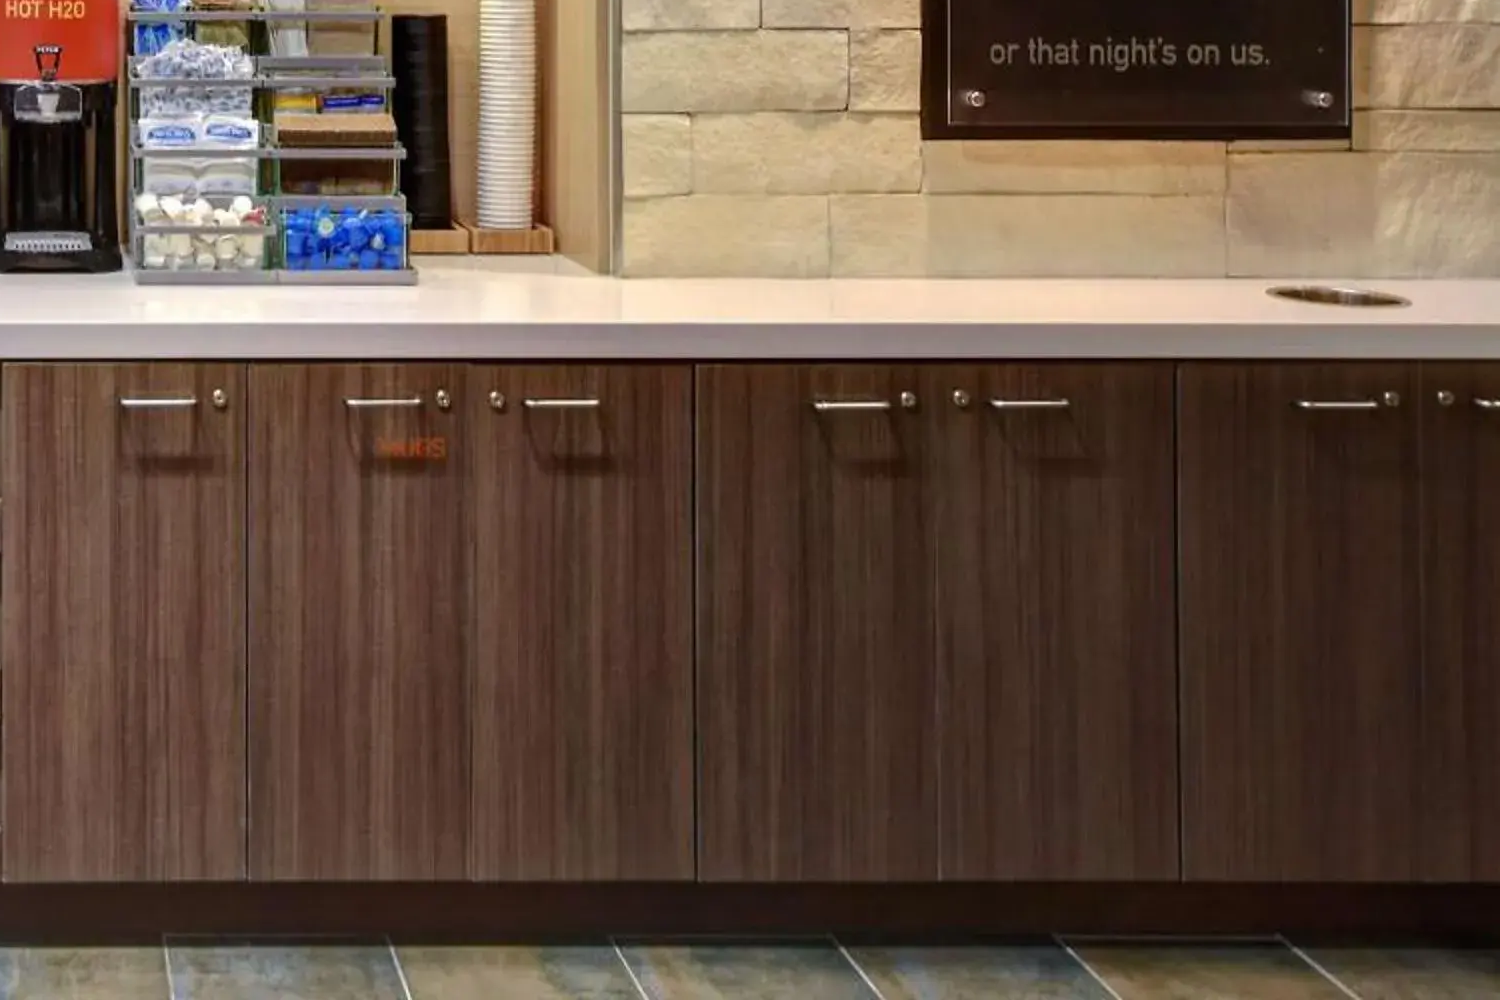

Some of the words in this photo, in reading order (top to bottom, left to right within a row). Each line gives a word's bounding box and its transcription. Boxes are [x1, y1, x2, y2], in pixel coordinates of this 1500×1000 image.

[5, 0, 43, 19] HOT
[990, 43, 1017, 65] or
[1028, 37, 1079, 66] that
[1089, 37, 1177, 73] night's
[1187, 44, 1220, 65] on
[1230, 44, 1270, 66] us.
